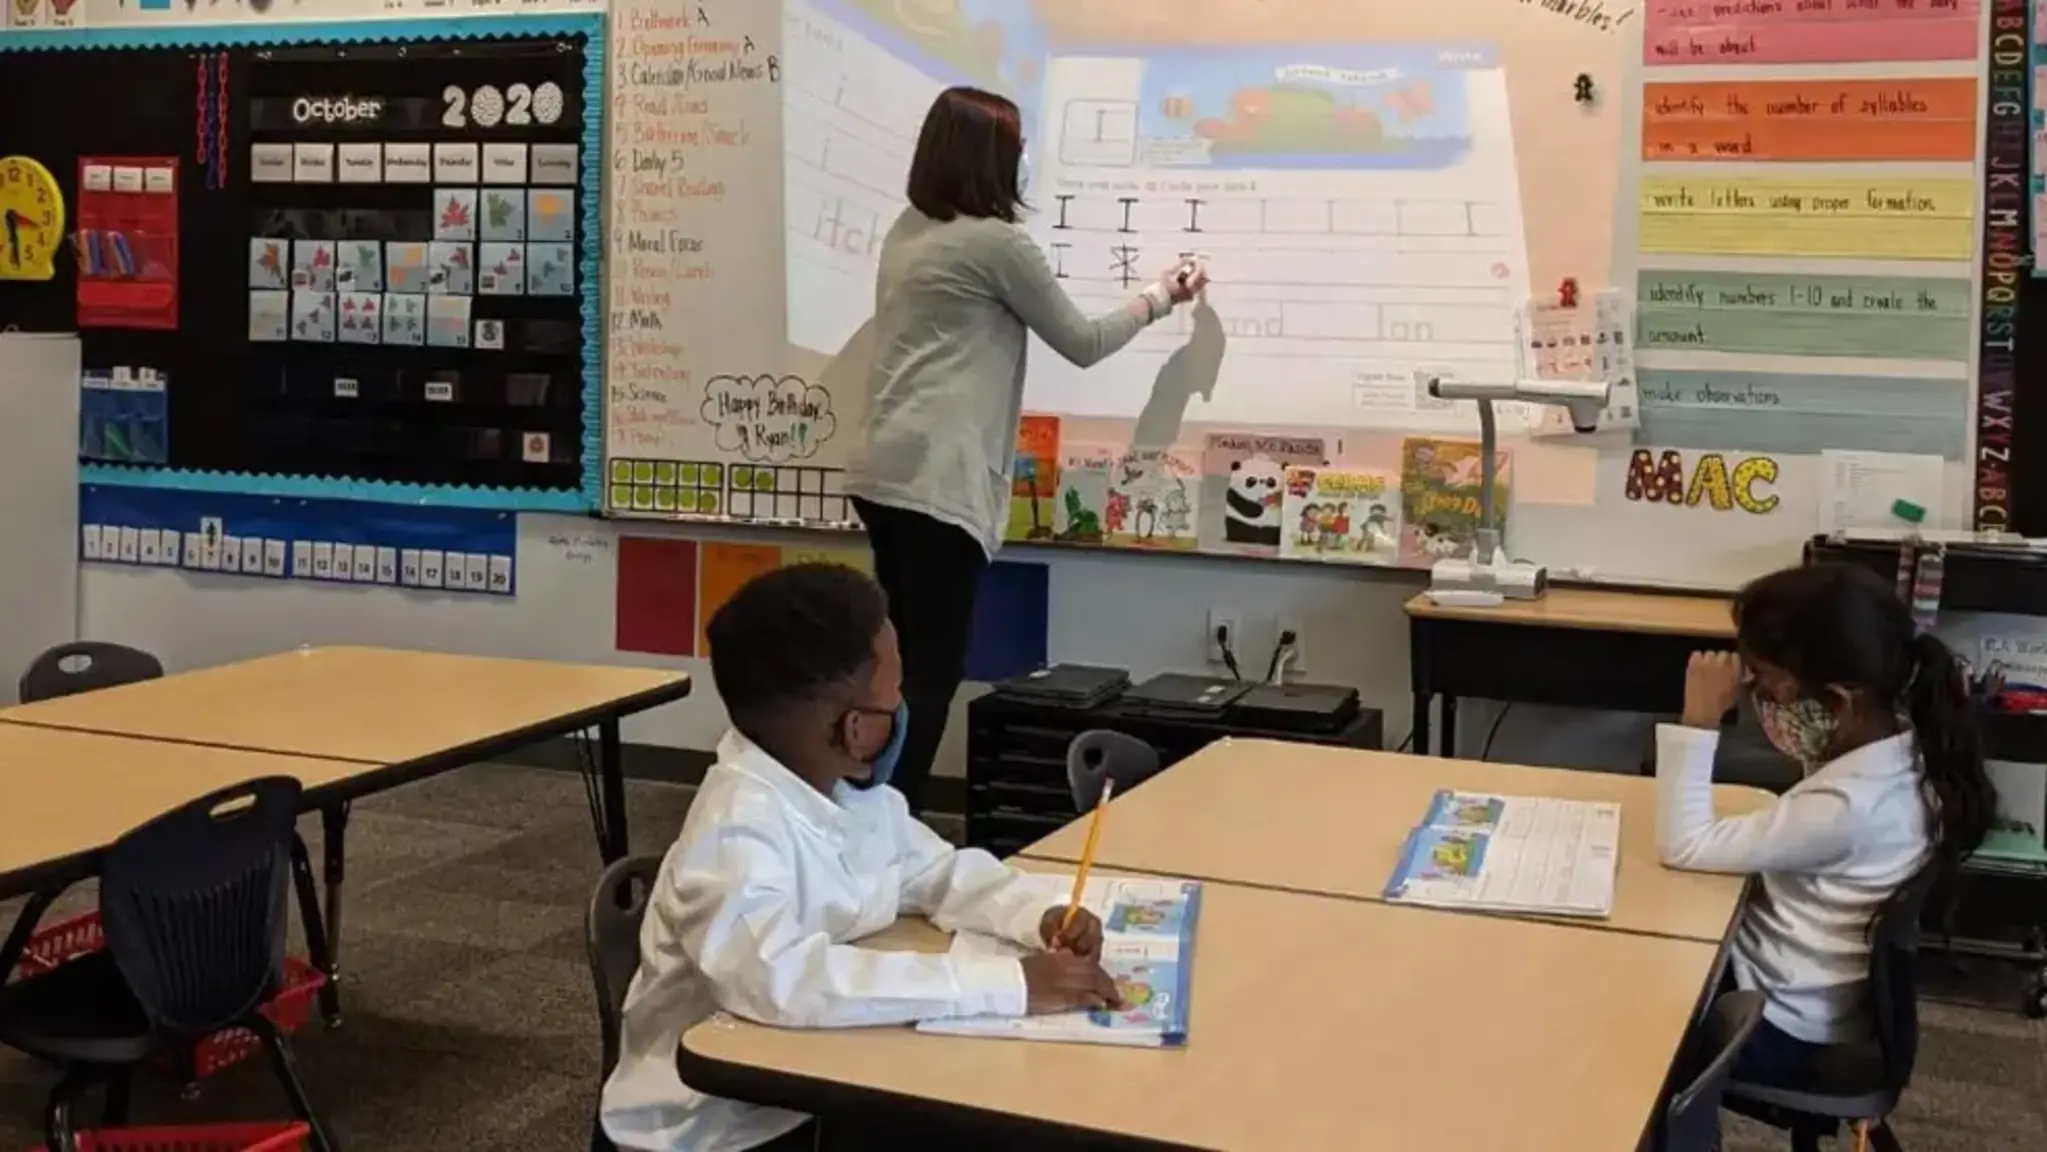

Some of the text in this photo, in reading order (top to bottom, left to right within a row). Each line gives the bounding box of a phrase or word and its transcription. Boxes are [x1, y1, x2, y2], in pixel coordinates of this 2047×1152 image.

[1690, 37, 1704, 56] be
[1719, 33, 1756, 55] about
[292, 81, 565, 128] October 2020
[1727, 93, 1749, 116] the
[1766, 93, 1819, 115] number
[1830, 92, 1848, 115] of
[1860, 91, 1928, 116] syllables
[1713, 131, 1752, 154] word
[1654, 186, 1695, 207] write
[1711, 187, 1755, 207] letters
[1812, 195, 1849, 213] proper
[1650, 282, 1704, 310] identify
[1719, 284, 1777, 306] numbers
[1789, 284, 1822, 308] 1-10
[1831, 287, 1853, 309] and
[1917, 289, 1938, 311] the
[1642, 380, 1781, 405] make observations
[718, 391, 761, 422] Happy
[1625, 449, 1781, 515] MAC
